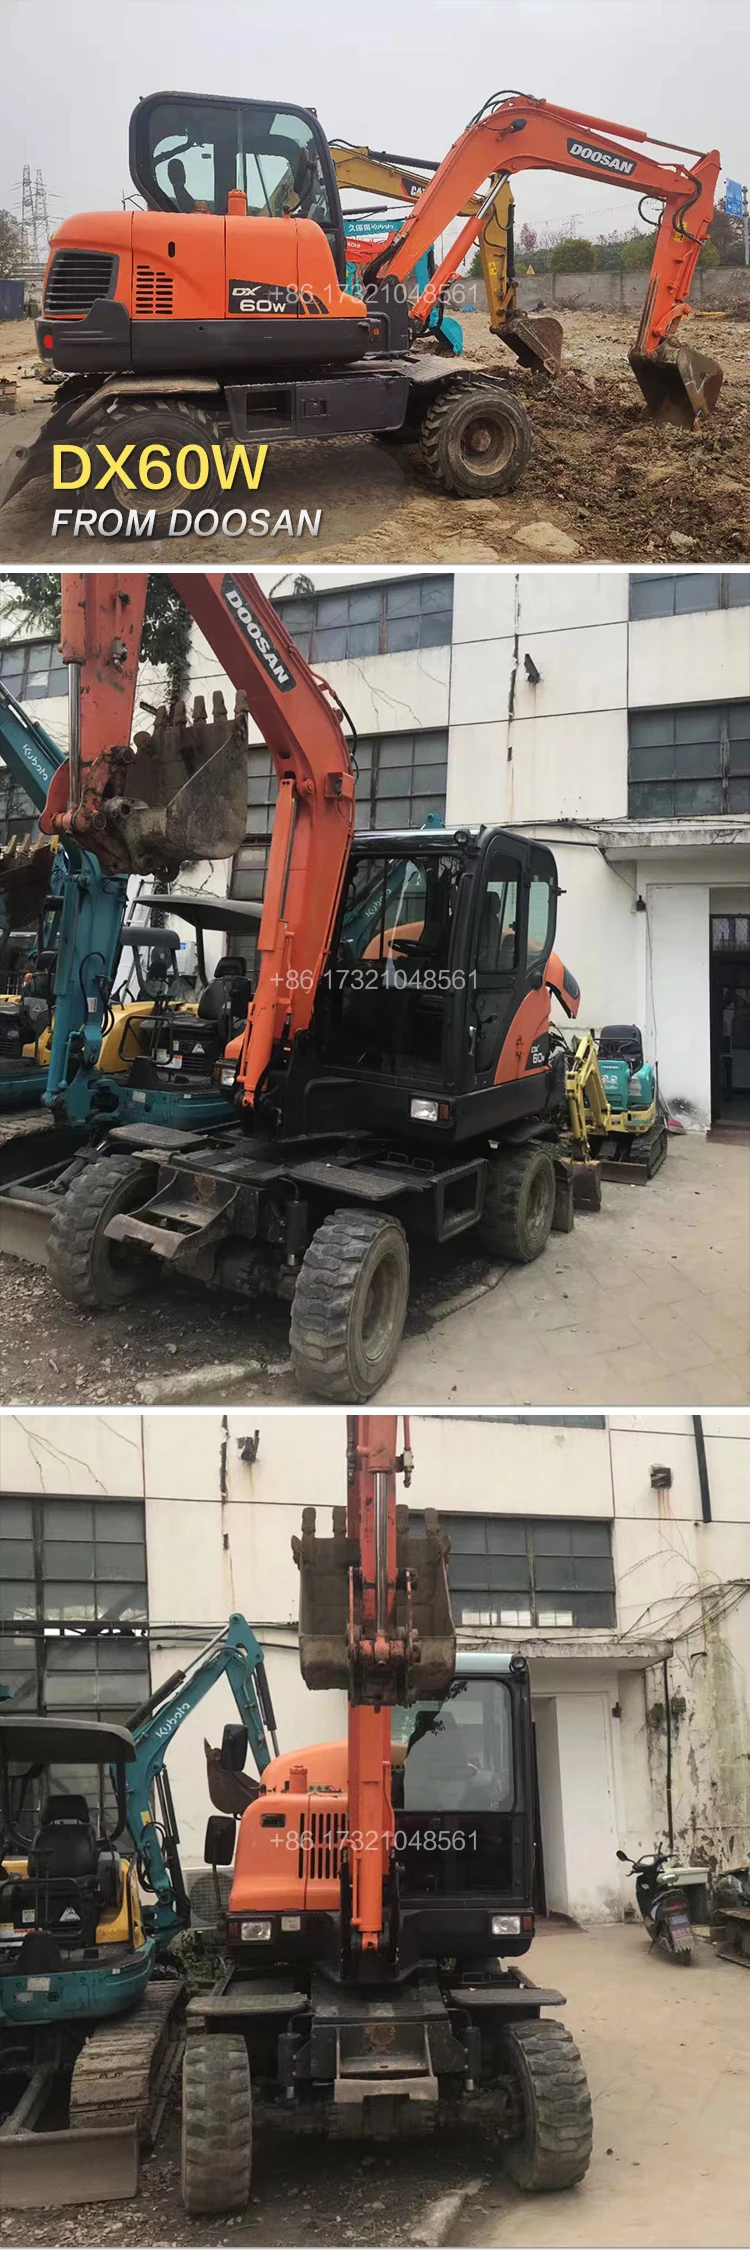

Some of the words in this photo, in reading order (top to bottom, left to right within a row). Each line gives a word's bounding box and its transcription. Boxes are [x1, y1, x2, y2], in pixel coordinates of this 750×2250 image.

[569, 143, 633, 174] DOOSAN
[232, 286, 262, 296] DX
[225, 590, 289, 684] DOOSAN
[22, 744, 48, 781] Kubota
[155, 1703, 190, 1738] Kubota
